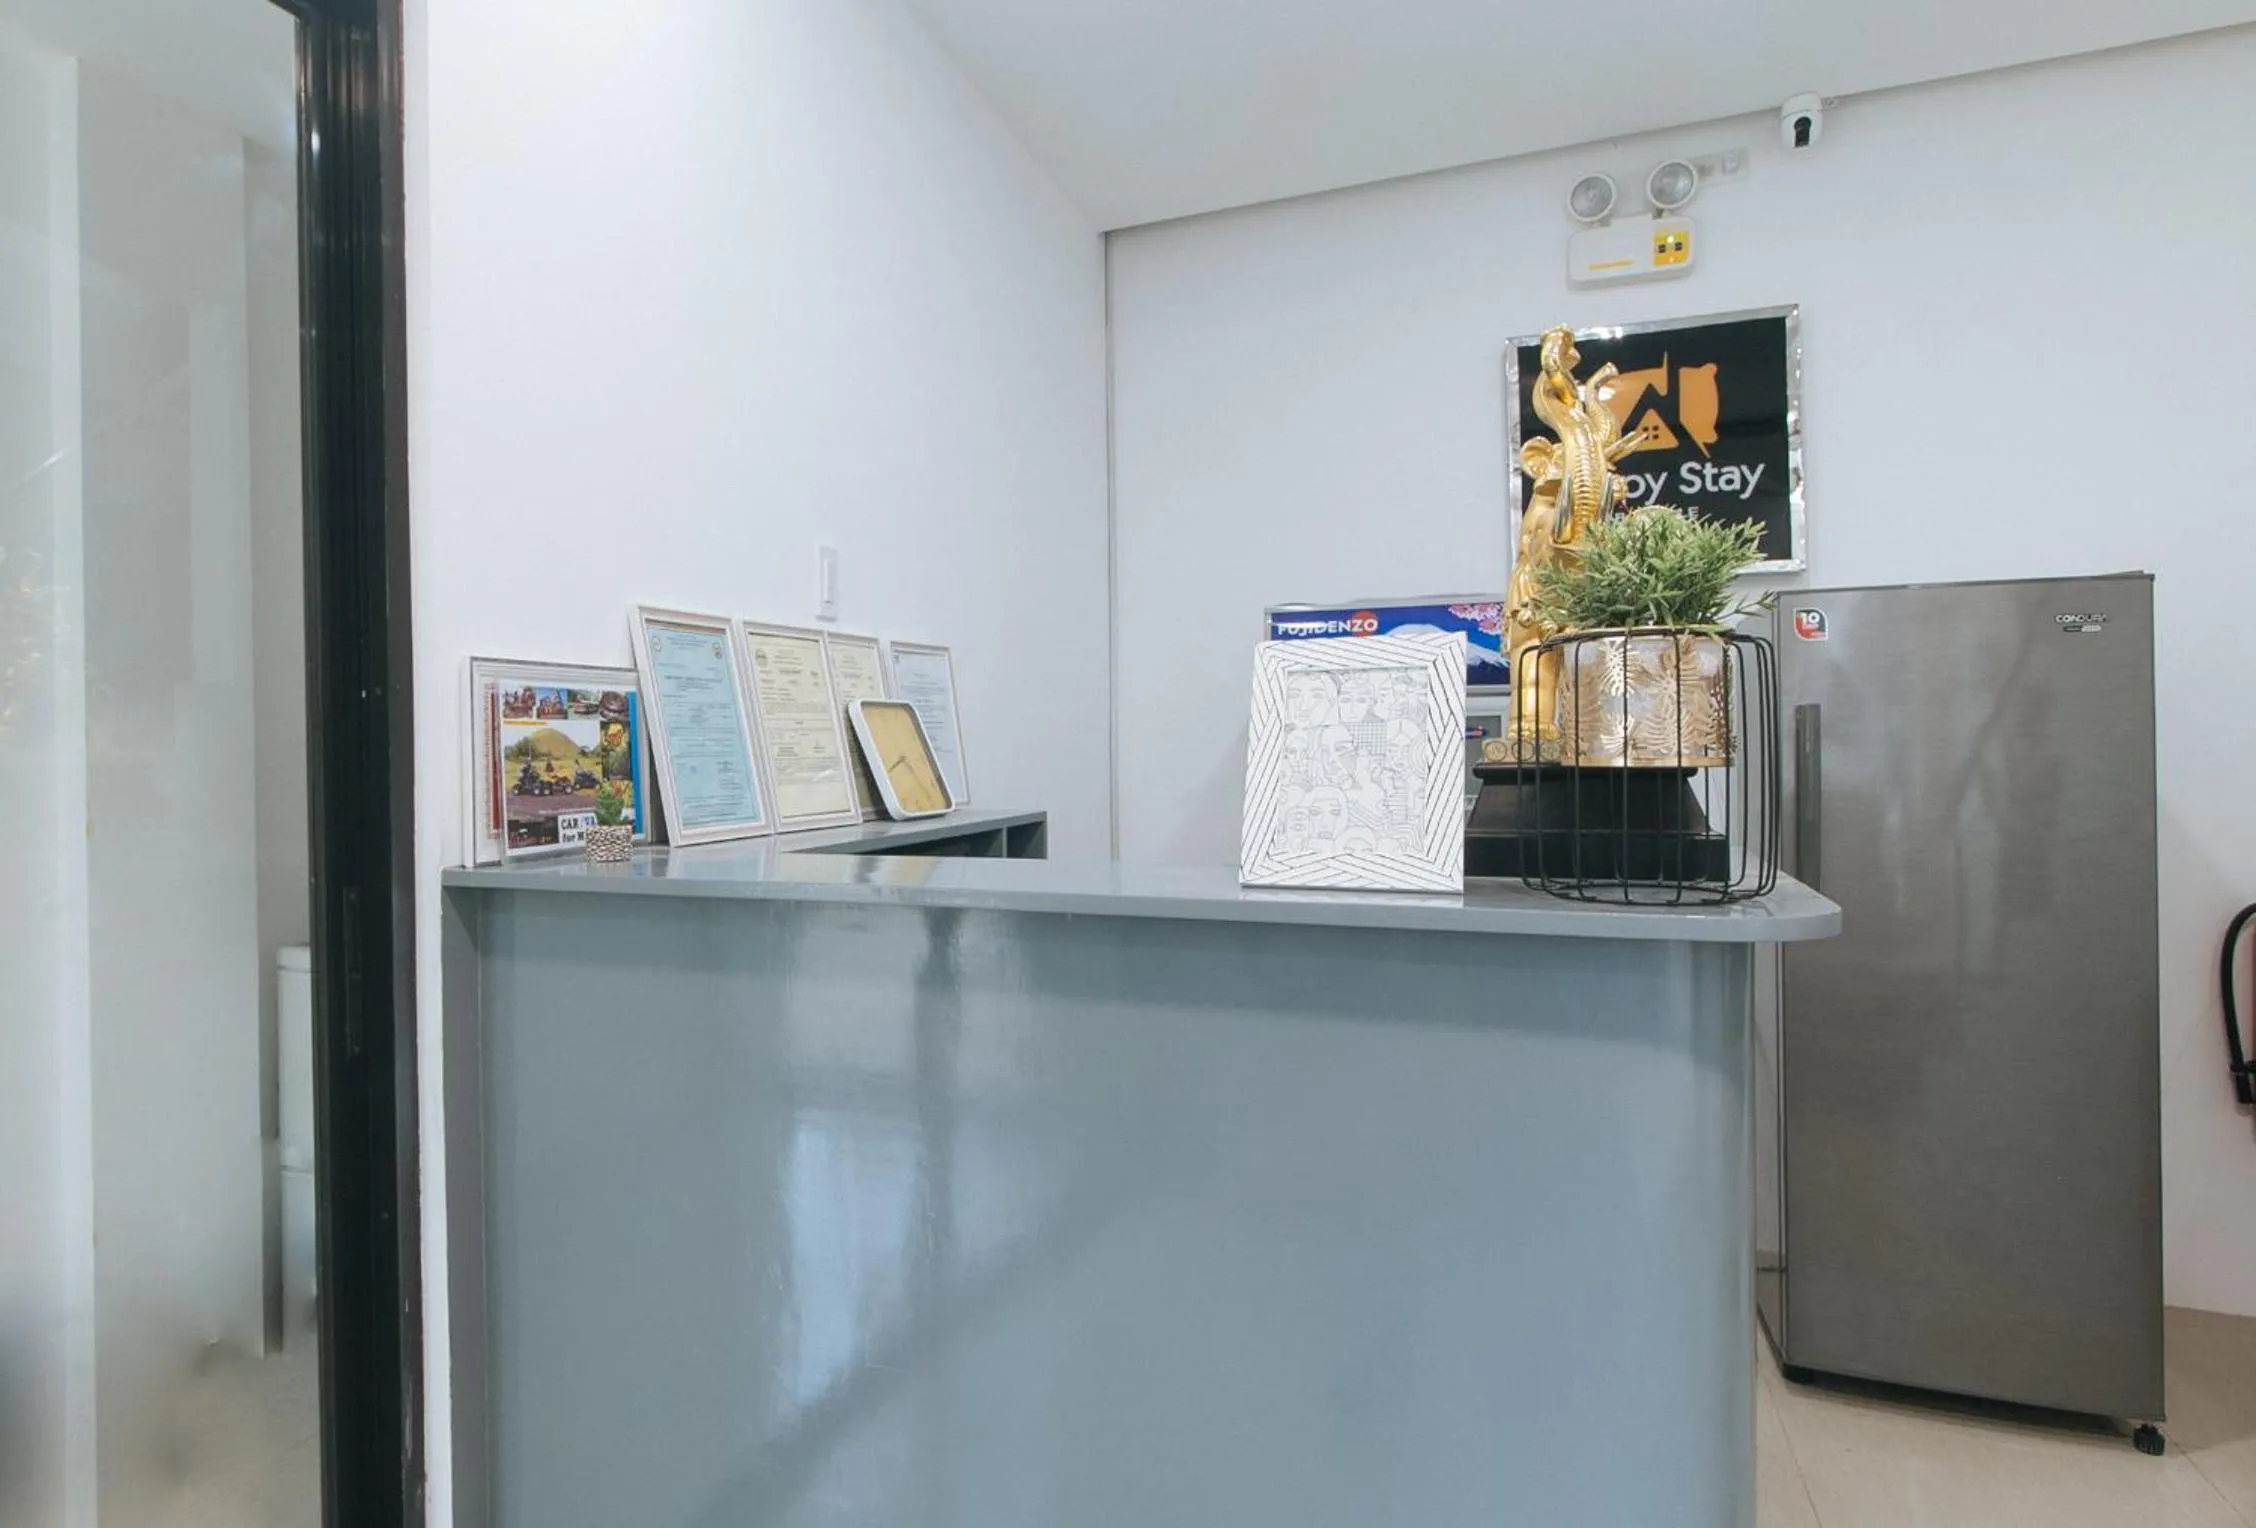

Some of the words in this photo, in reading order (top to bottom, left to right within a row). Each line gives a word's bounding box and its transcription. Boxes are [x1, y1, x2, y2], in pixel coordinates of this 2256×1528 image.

[1678, 460, 1766, 500] Stay
[1277, 618, 1379, 636] FUJIDENZO
[1799, 611, 1821, 625] 10
